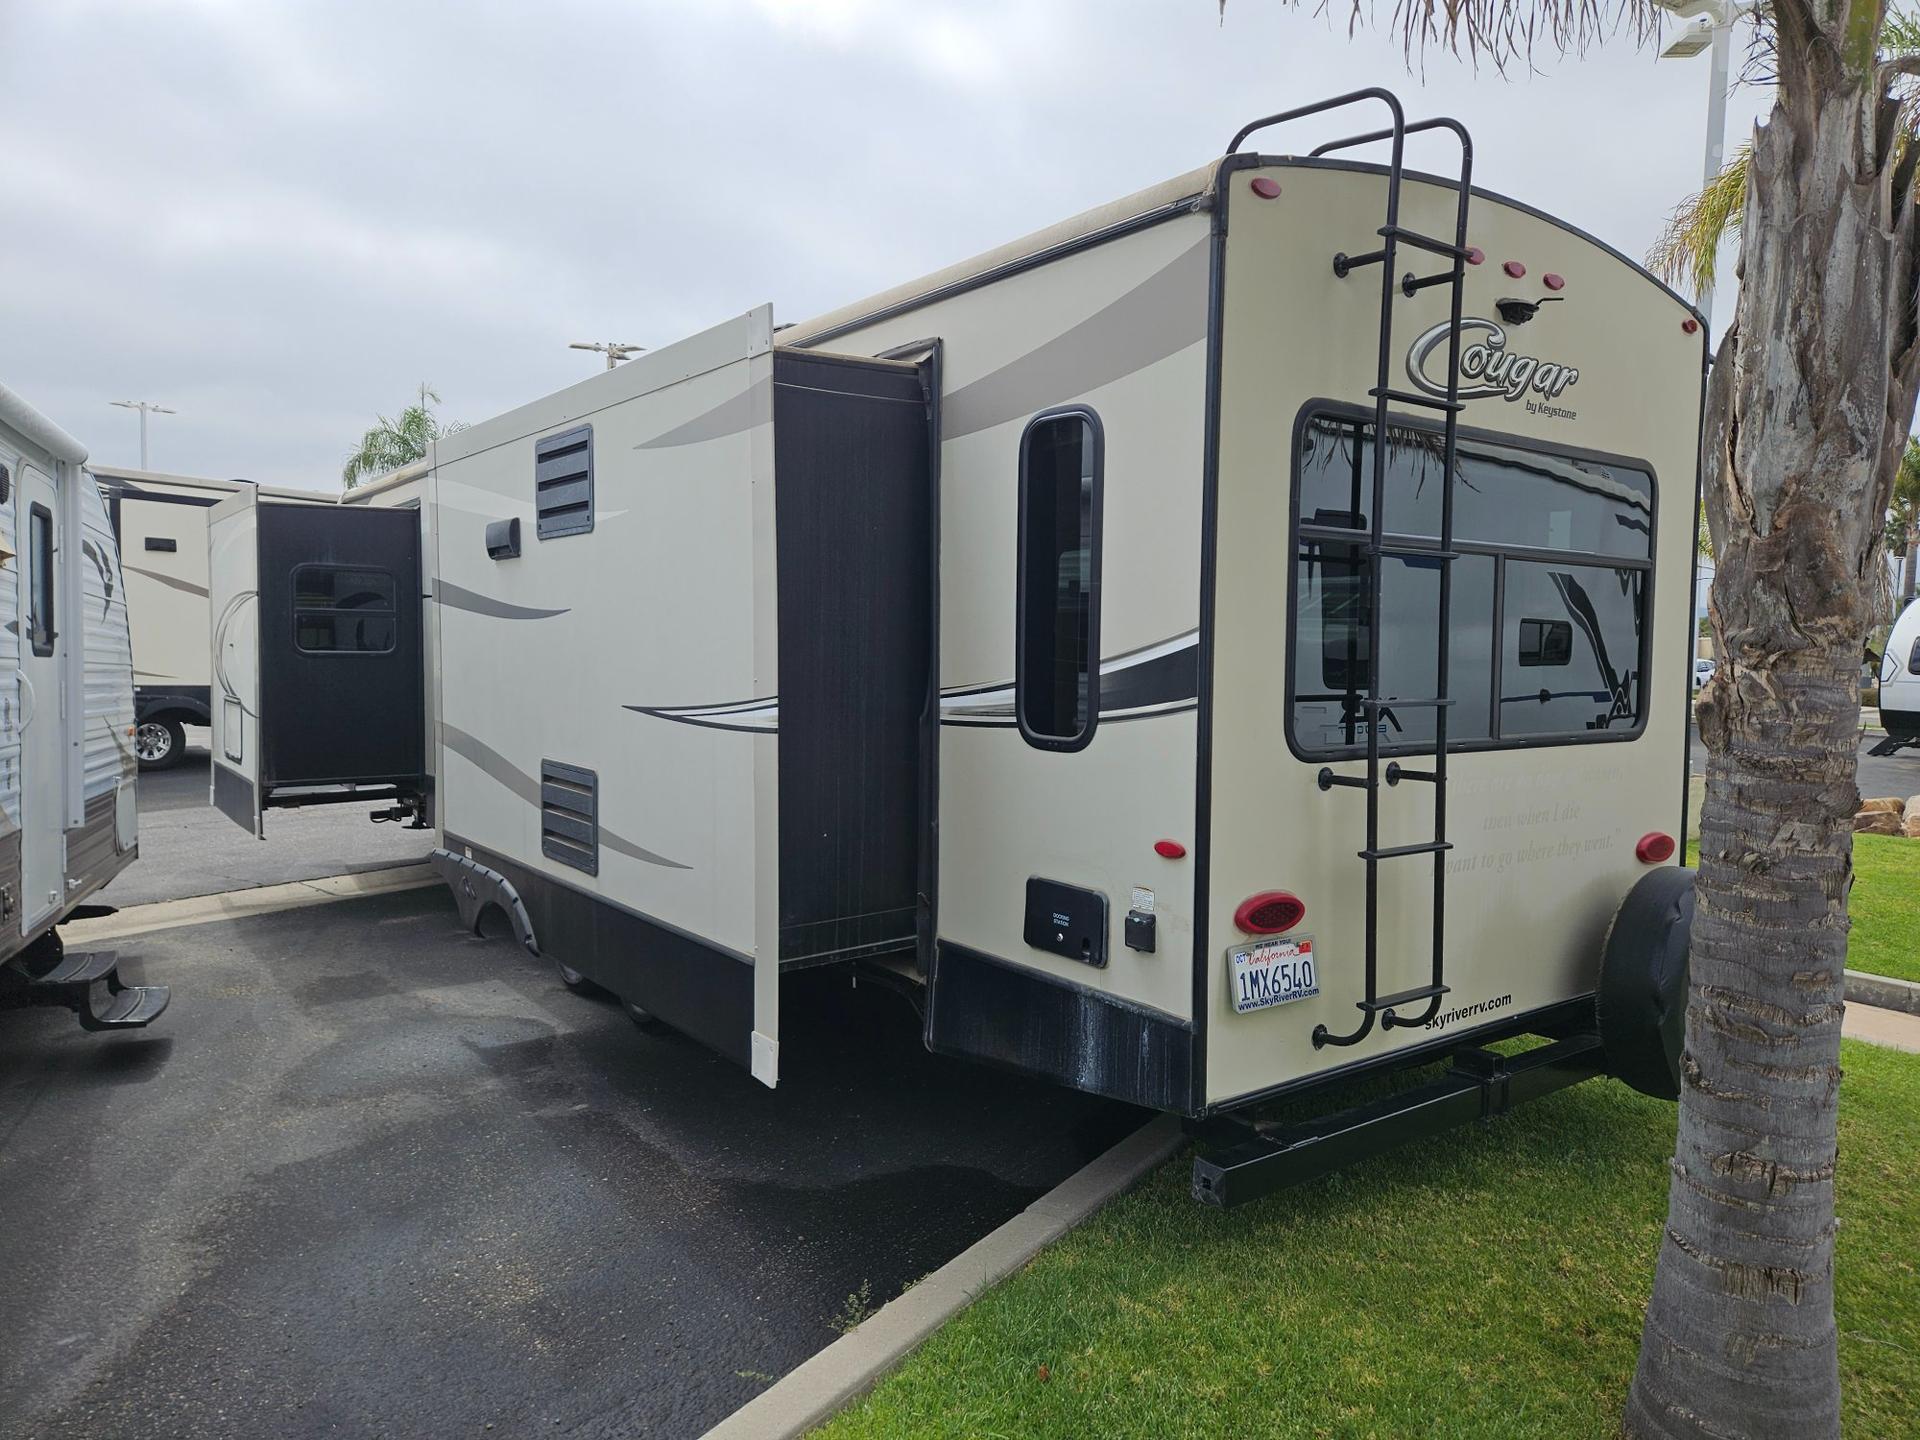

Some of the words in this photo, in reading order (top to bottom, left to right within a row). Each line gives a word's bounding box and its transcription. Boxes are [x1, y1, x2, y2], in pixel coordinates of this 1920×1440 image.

[1405, 316, 1579, 402] Cougar
[1526, 400, 1536, 415] by
[1537, 403, 1577, 421] Keystone
[1481, 853, 1495, 870] to
[1499, 854, 1513, 874] go
[1517, 838, 1556, 864] where
[1248, 948, 1299, 966] California
[1237, 986, 1320, 1011] www.SkyRiverRV.com
[1239, 960, 1313, 1001] 1MX6540
[1425, 993, 1512, 1030] skyriverrv.com
